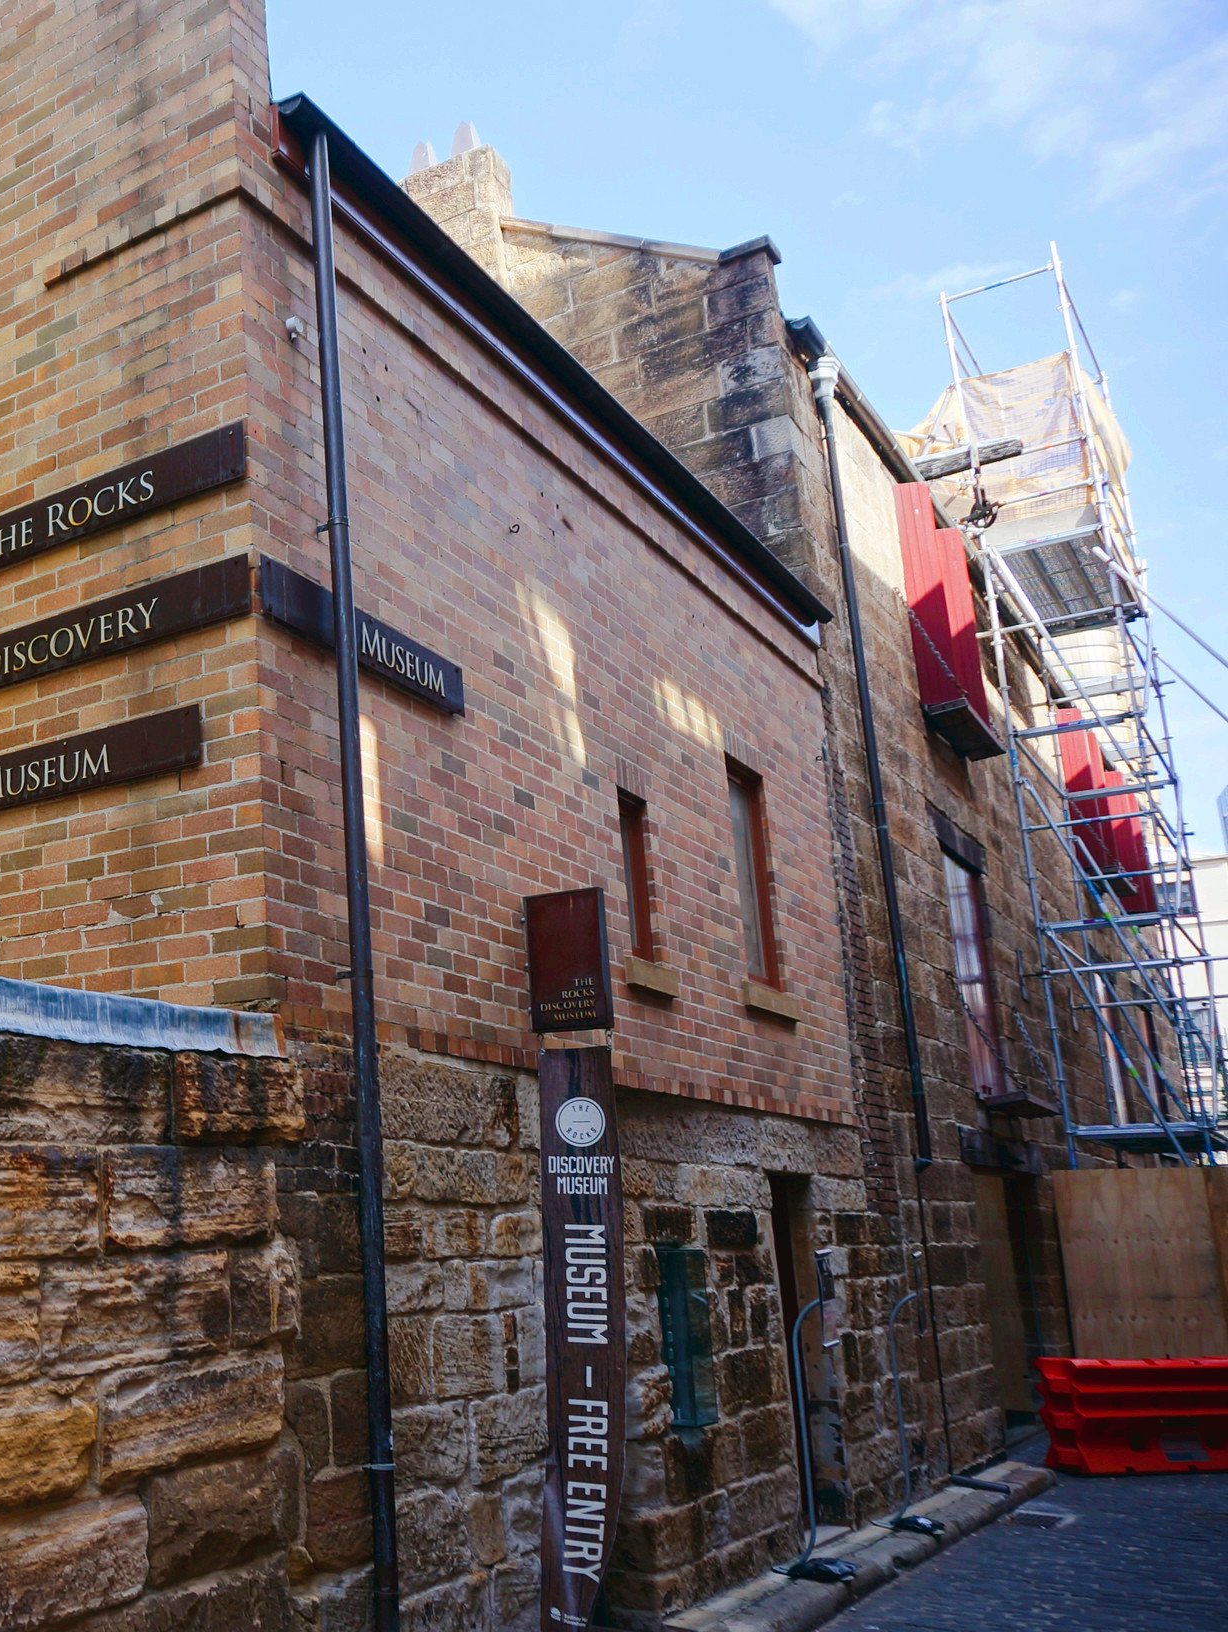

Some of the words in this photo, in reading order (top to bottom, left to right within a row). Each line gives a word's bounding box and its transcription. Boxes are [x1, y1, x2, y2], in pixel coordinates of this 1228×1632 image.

[46, 470, 155, 538] ROCKS
[360, 621, 447, 697] MUSEUM
[573, 977, 595, 987] THE
[561, 988, 595, 999] ROCKS
[540, 999, 596, 1012] DISCOVERY
[553, 1010, 597, 1021] MUSEUM
[572, 1104, 590, 1113] THE
[566, 1127, 597, 1140] ROCKS
[548, 1155, 615, 1174] DISCOVERY
[556, 1176, 608, 1195] MUSEUM
[564, 1223, 608, 1345] MUSEUM
[567, 1398, 609, 1471] FREE
[562, 1480, 607, 1584] ENTRY
